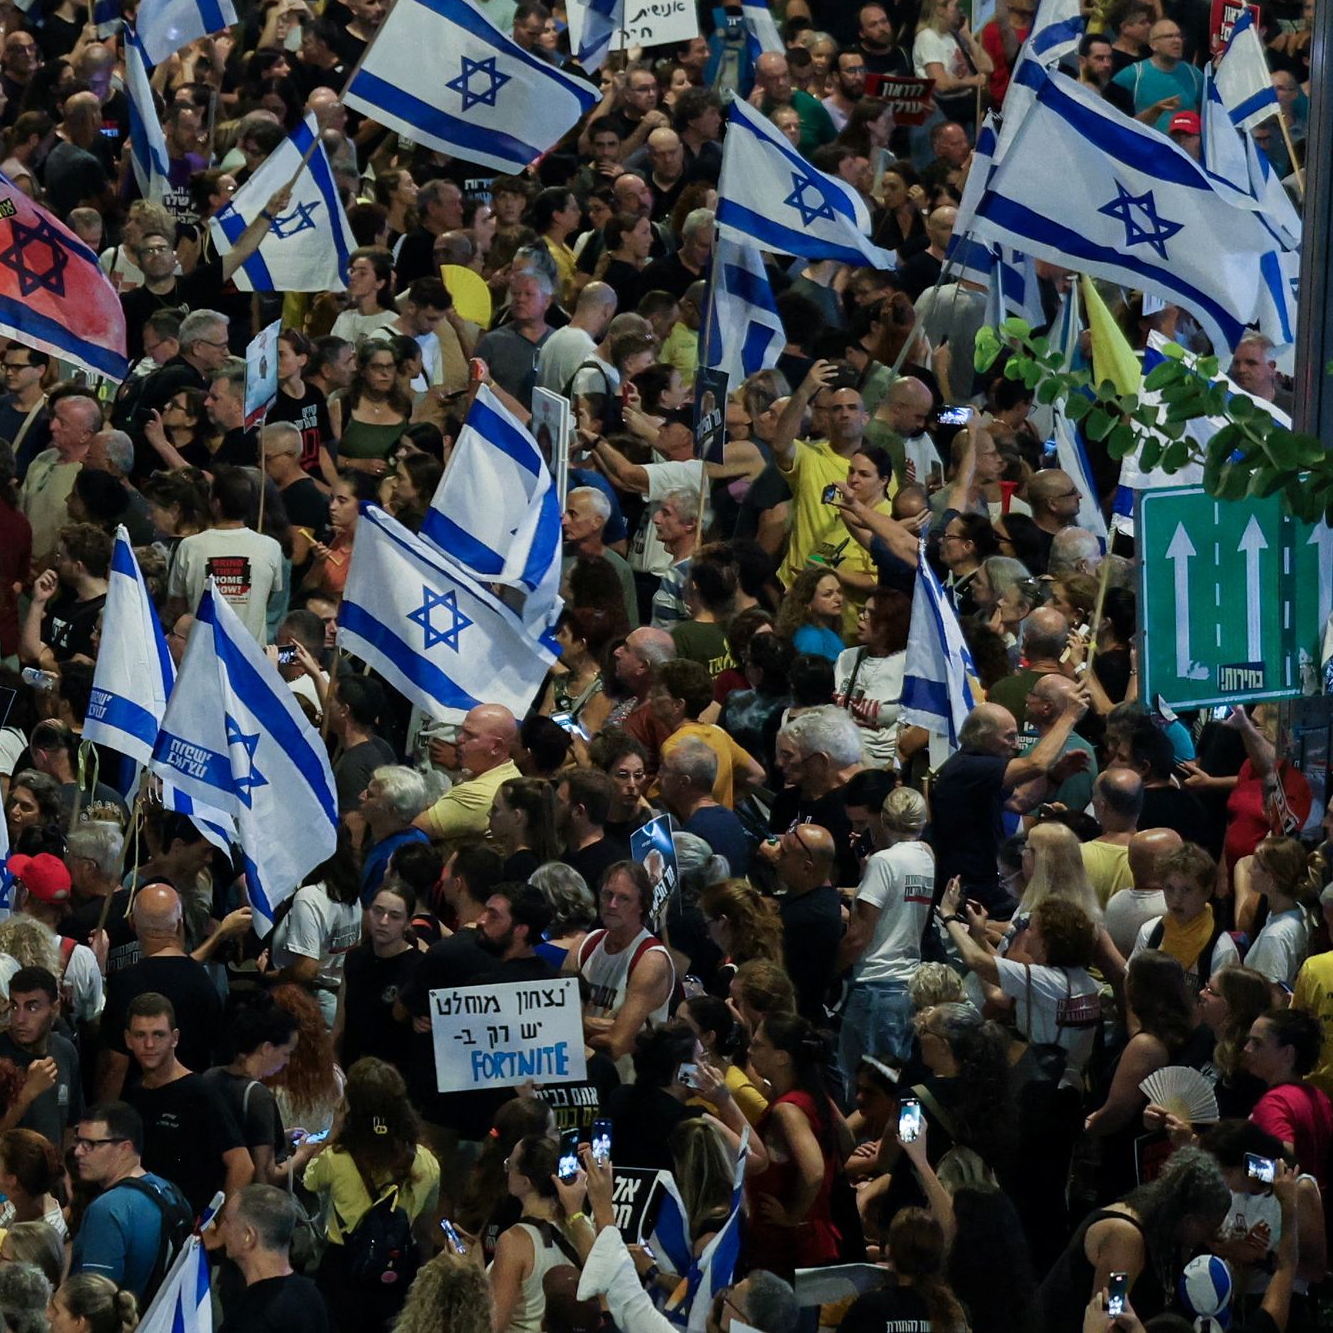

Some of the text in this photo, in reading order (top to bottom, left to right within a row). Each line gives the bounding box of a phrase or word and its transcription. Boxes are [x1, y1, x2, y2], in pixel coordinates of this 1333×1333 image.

[630, 1, 686, 24] אנושית
[1221, 667, 1264, 691] בחירות!
[486, 1024, 509, 1050] רק
[520, 1022, 543, 1040] יש
[471, 1042, 569, 1082] FORTNITE
